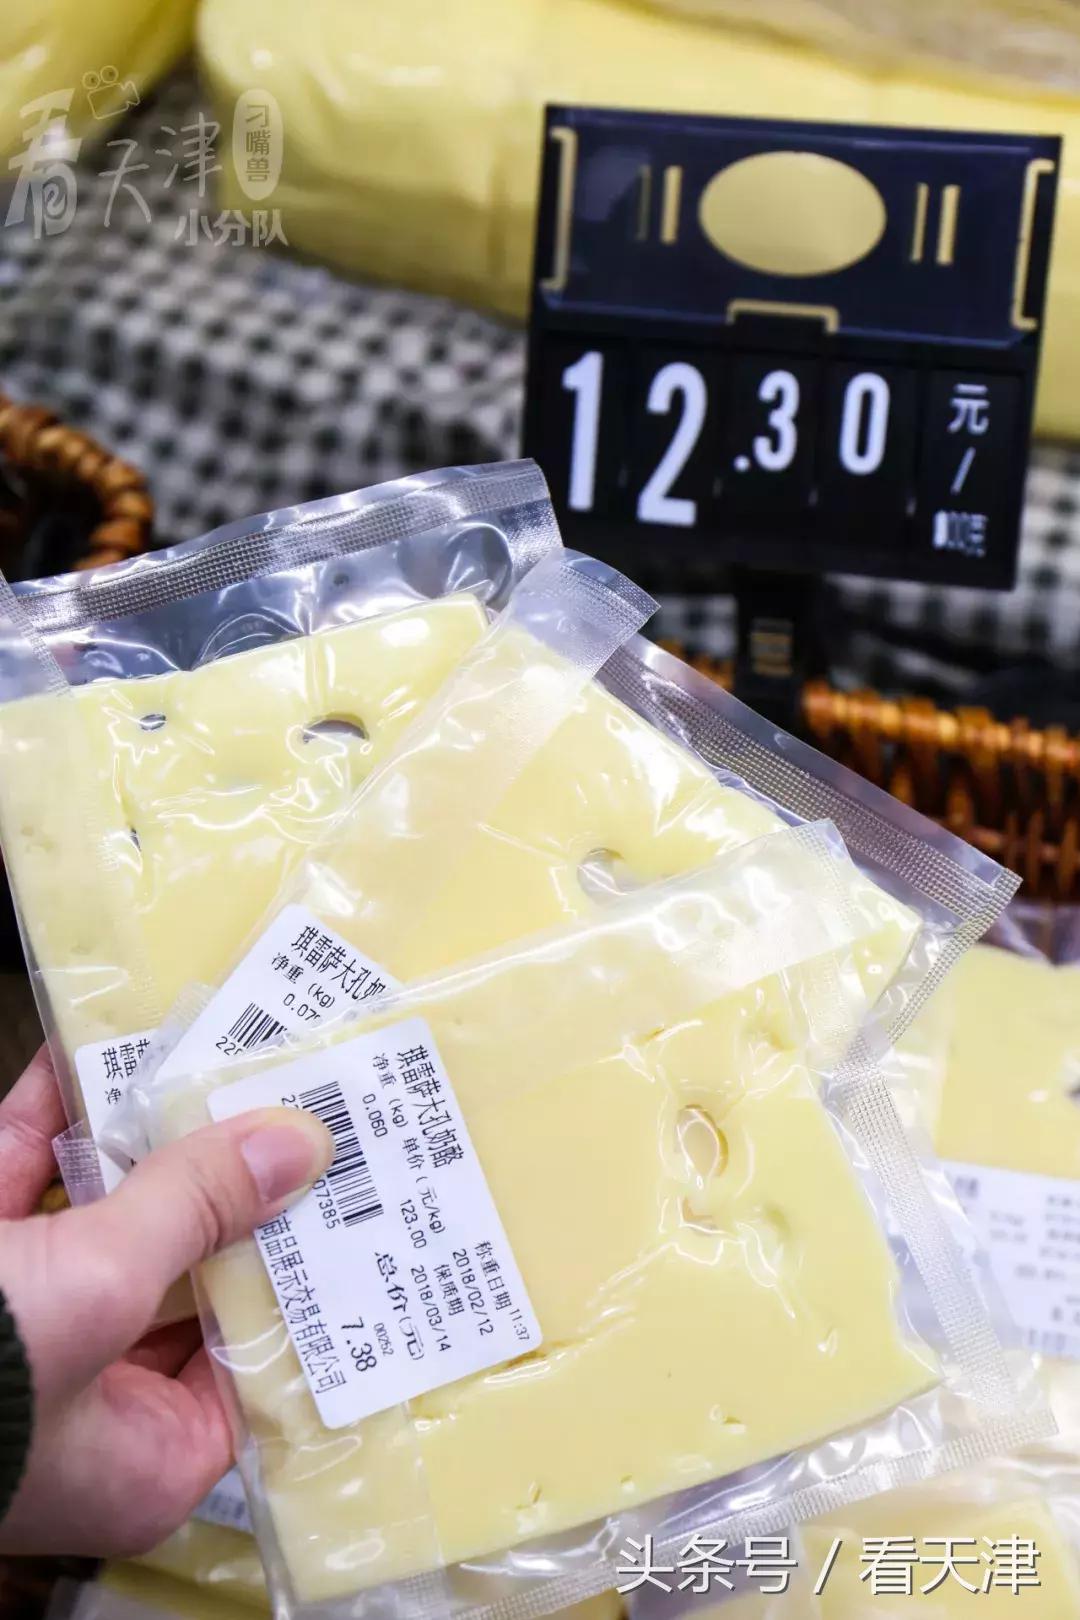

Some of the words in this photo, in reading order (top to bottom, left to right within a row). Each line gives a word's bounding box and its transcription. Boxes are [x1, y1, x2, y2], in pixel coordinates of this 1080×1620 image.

[562, 351, 890, 526] 12.30
[271, 952, 305, 985] 净重
[283, 993, 321, 1022] 0.07
[215, 1036, 243, 1056] 22
[362, 1093, 388, 1138] 0.060
[397, 1044, 464, 1168] 琪雷萨大孔奶酪
[400, 1198, 427, 1249] 123.00
[257, 1209, 347, 1394] 商品展示交易有限公司
[410, 1264, 452, 1352] 2018/03/14
[434, 1264, 465, 1316] 保质期
[452, 1248, 494, 1336] 2018/02/12
[475, 1240, 512, 1311] 称重日期
[509, 1308, 530, 1341] 11:37
[341, 1316, 377, 1372] 7.38
